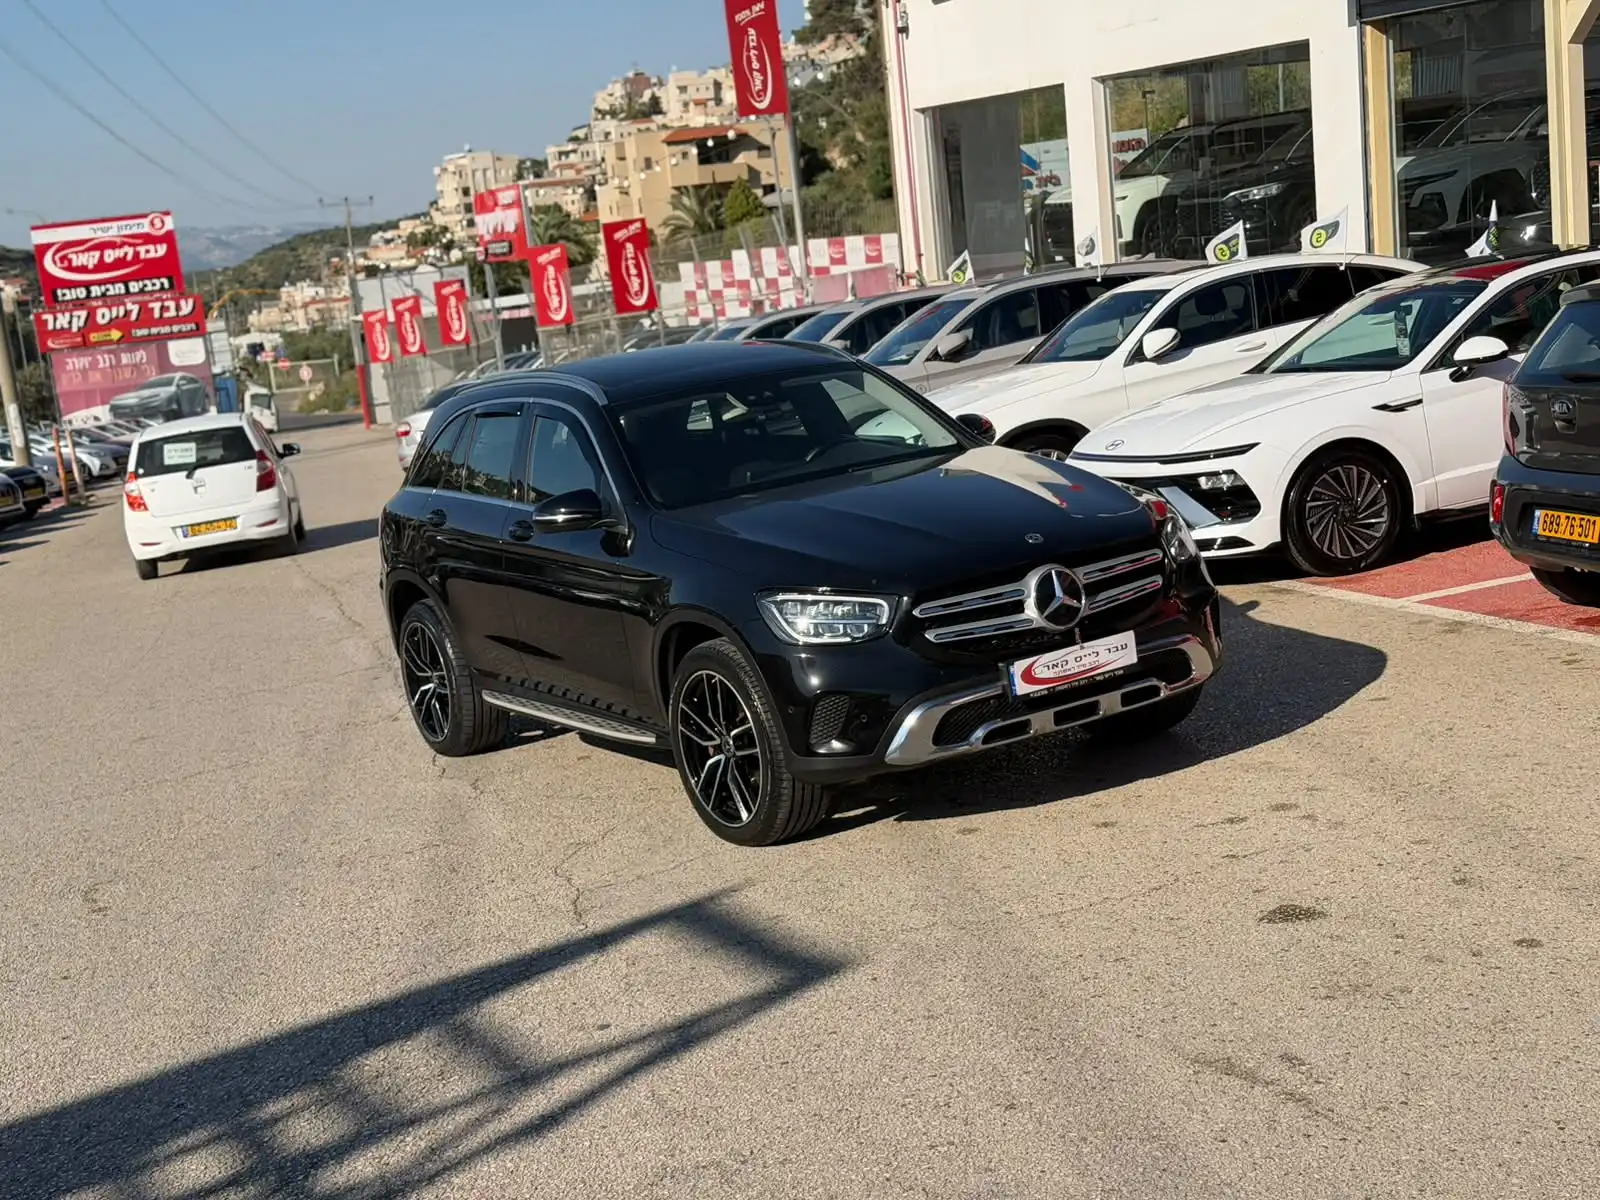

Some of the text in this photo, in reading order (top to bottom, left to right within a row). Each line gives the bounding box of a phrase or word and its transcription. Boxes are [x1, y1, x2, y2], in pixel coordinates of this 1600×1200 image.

[89, 222, 145, 234] מימון ישיר
[67, 243, 167, 269] עבד לייס קאר
[56, 277, 170, 301] רכבים מבית טוב!
[41, 298, 195, 332] עבד לייס קאר
[1043, 659, 1069, 672] קאר
[1074, 650, 1100, 663] לייס
